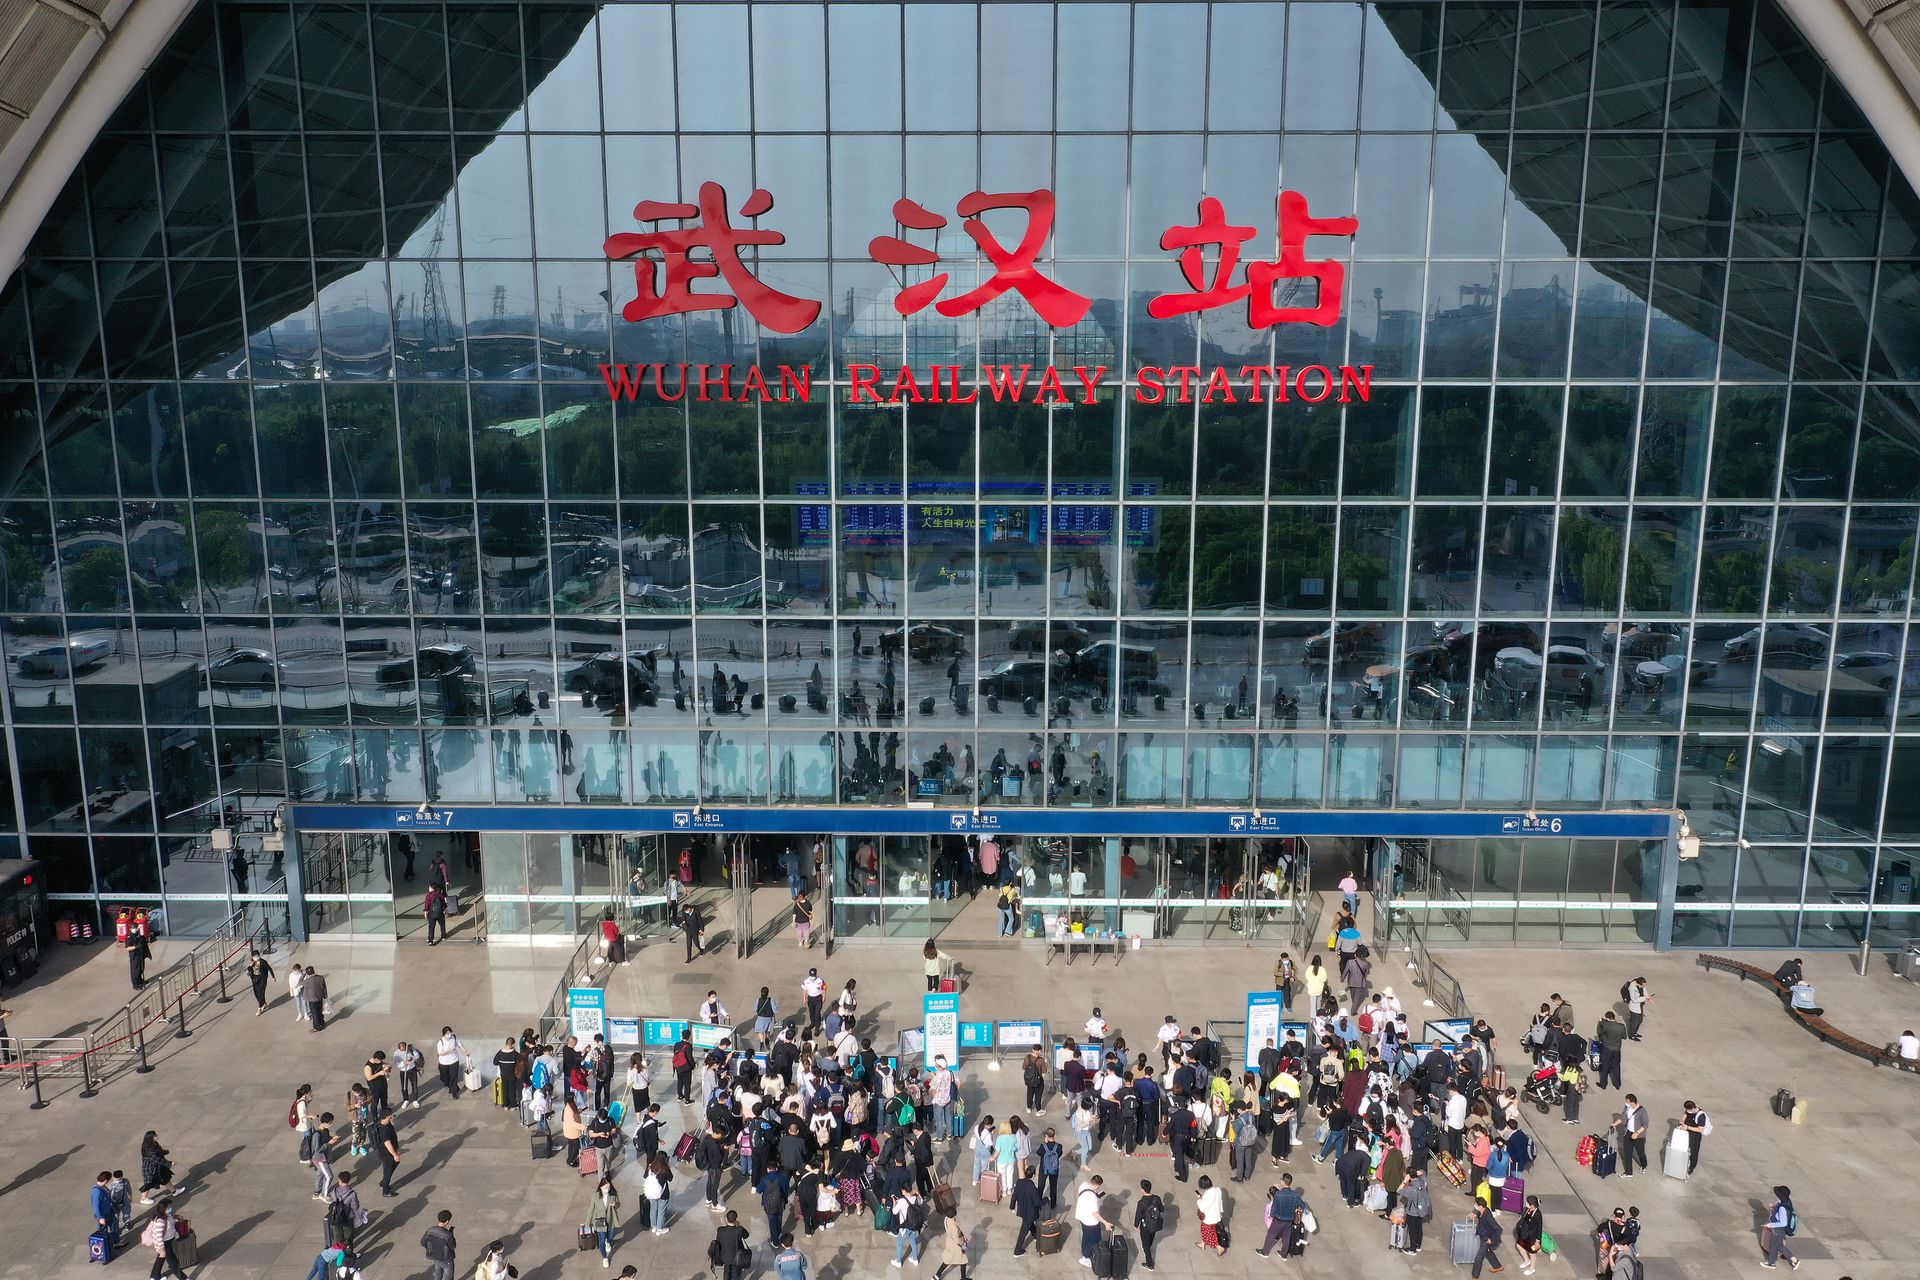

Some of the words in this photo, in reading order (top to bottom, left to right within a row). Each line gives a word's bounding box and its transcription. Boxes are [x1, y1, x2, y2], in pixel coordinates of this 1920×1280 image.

[603, 181, 1359, 333] 武汉站
[599, 363, 812, 404] WUHAN
[847, 363, 1108, 406] RAILWAY
[1135, 363, 1375, 404] STATION
[921, 506, 954, 516] 有活力
[921, 518, 987, 529] 人生自有光芒
[443, 811, 454, 826] 7
[694, 813, 720, 822] 东进口
[971, 815, 997, 823] 东进口
[1250, 817, 1276, 825] 东进口
[1551, 818, 1562, 833] 6
[6, 930, 22, 947] POLICE
